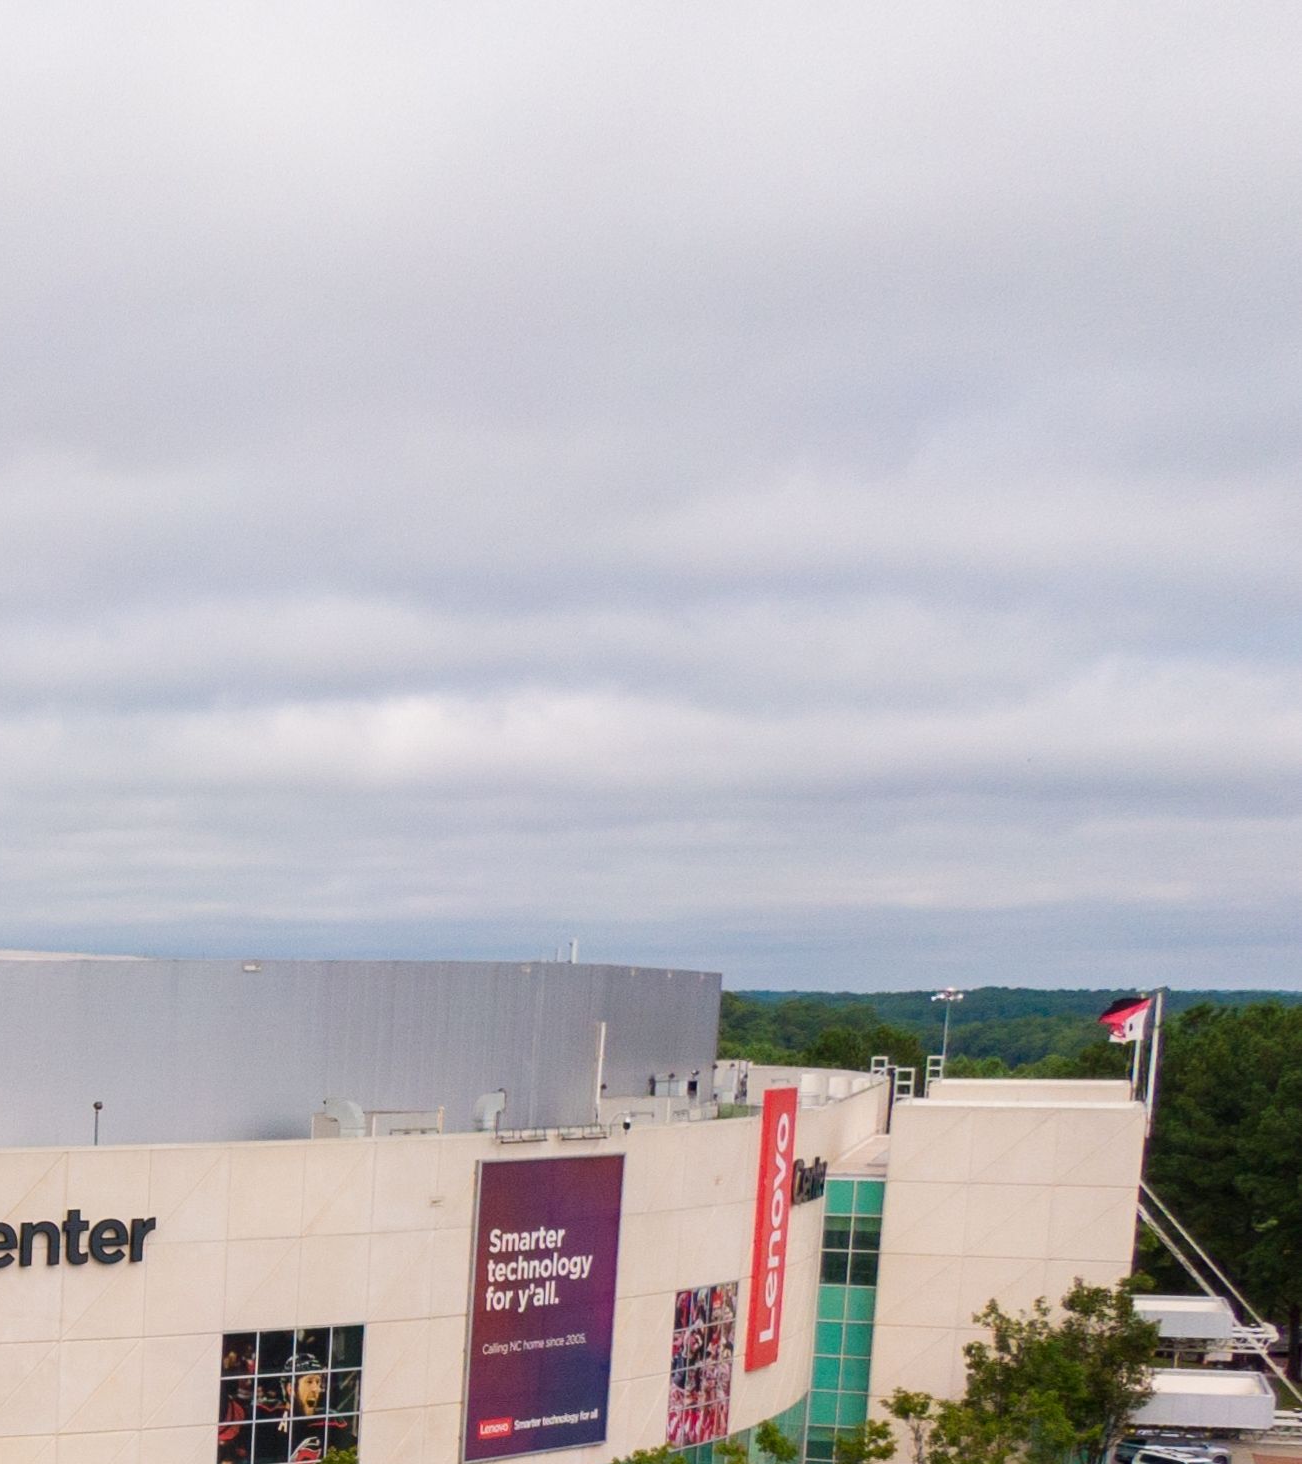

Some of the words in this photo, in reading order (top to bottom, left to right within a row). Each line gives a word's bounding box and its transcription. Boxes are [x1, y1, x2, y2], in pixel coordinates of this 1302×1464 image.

[488, 1226, 566, 1253] Smarter
[759, 1112, 790, 1343] Lenovo
[487, 1252, 593, 1283] technology
[485, 1286, 514, 1312] for
[482, 1342, 508, 1355] Calling
[509, 1340, 522, 1352] NC
[522, 1337, 545, 1351] home
[545, 1336, 565, 1347] since
[480, 1421, 509, 1435] Lenovo
[514, 1416, 541, 1431] Smarter
[542, 1411, 579, 1427] technology
[579, 1409, 590, 1421] for
[590, 1408, 599, 1419] all
